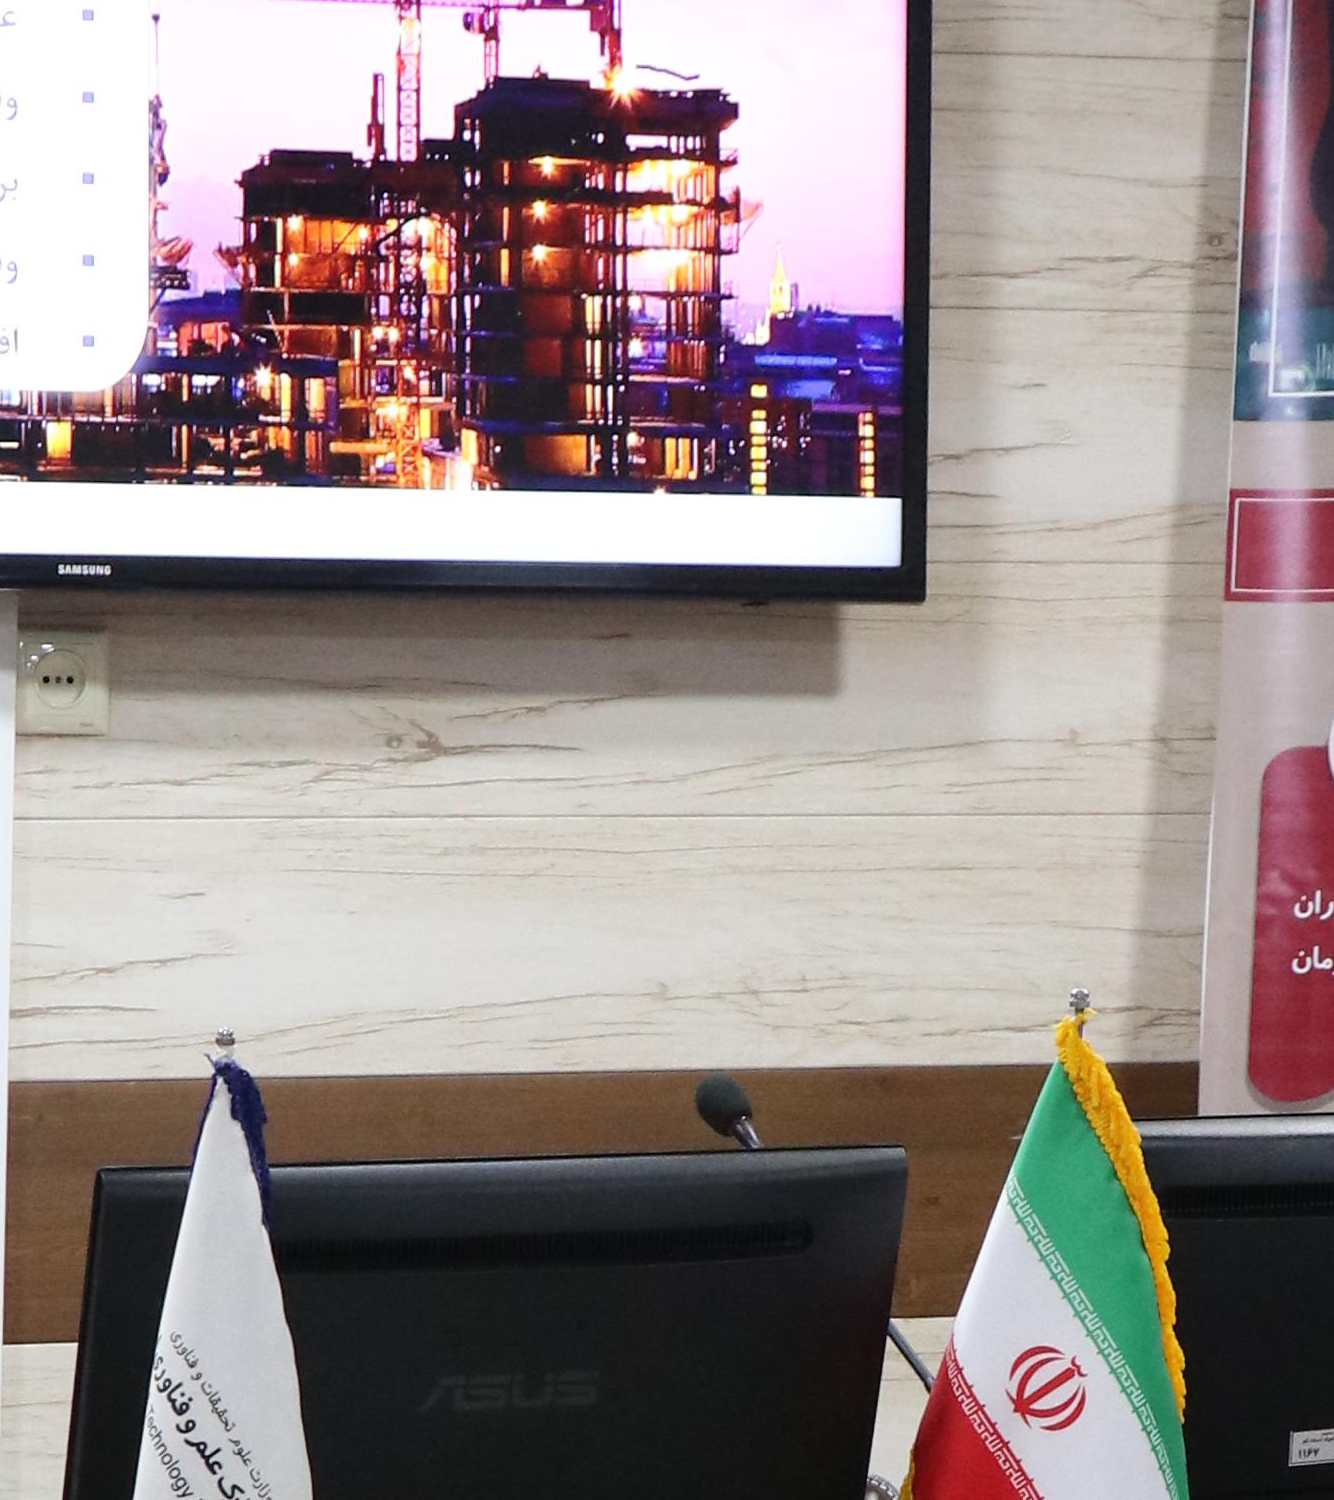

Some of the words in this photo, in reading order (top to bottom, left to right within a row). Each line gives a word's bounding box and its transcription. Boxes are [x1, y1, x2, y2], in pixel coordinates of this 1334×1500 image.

[58, 564, 112, 576] SAMSUNG
[417, 1371, 603, 1413] ASUS
[175, 1418, 197, 1435] و
[183, 1437, 223, 1476] علم
